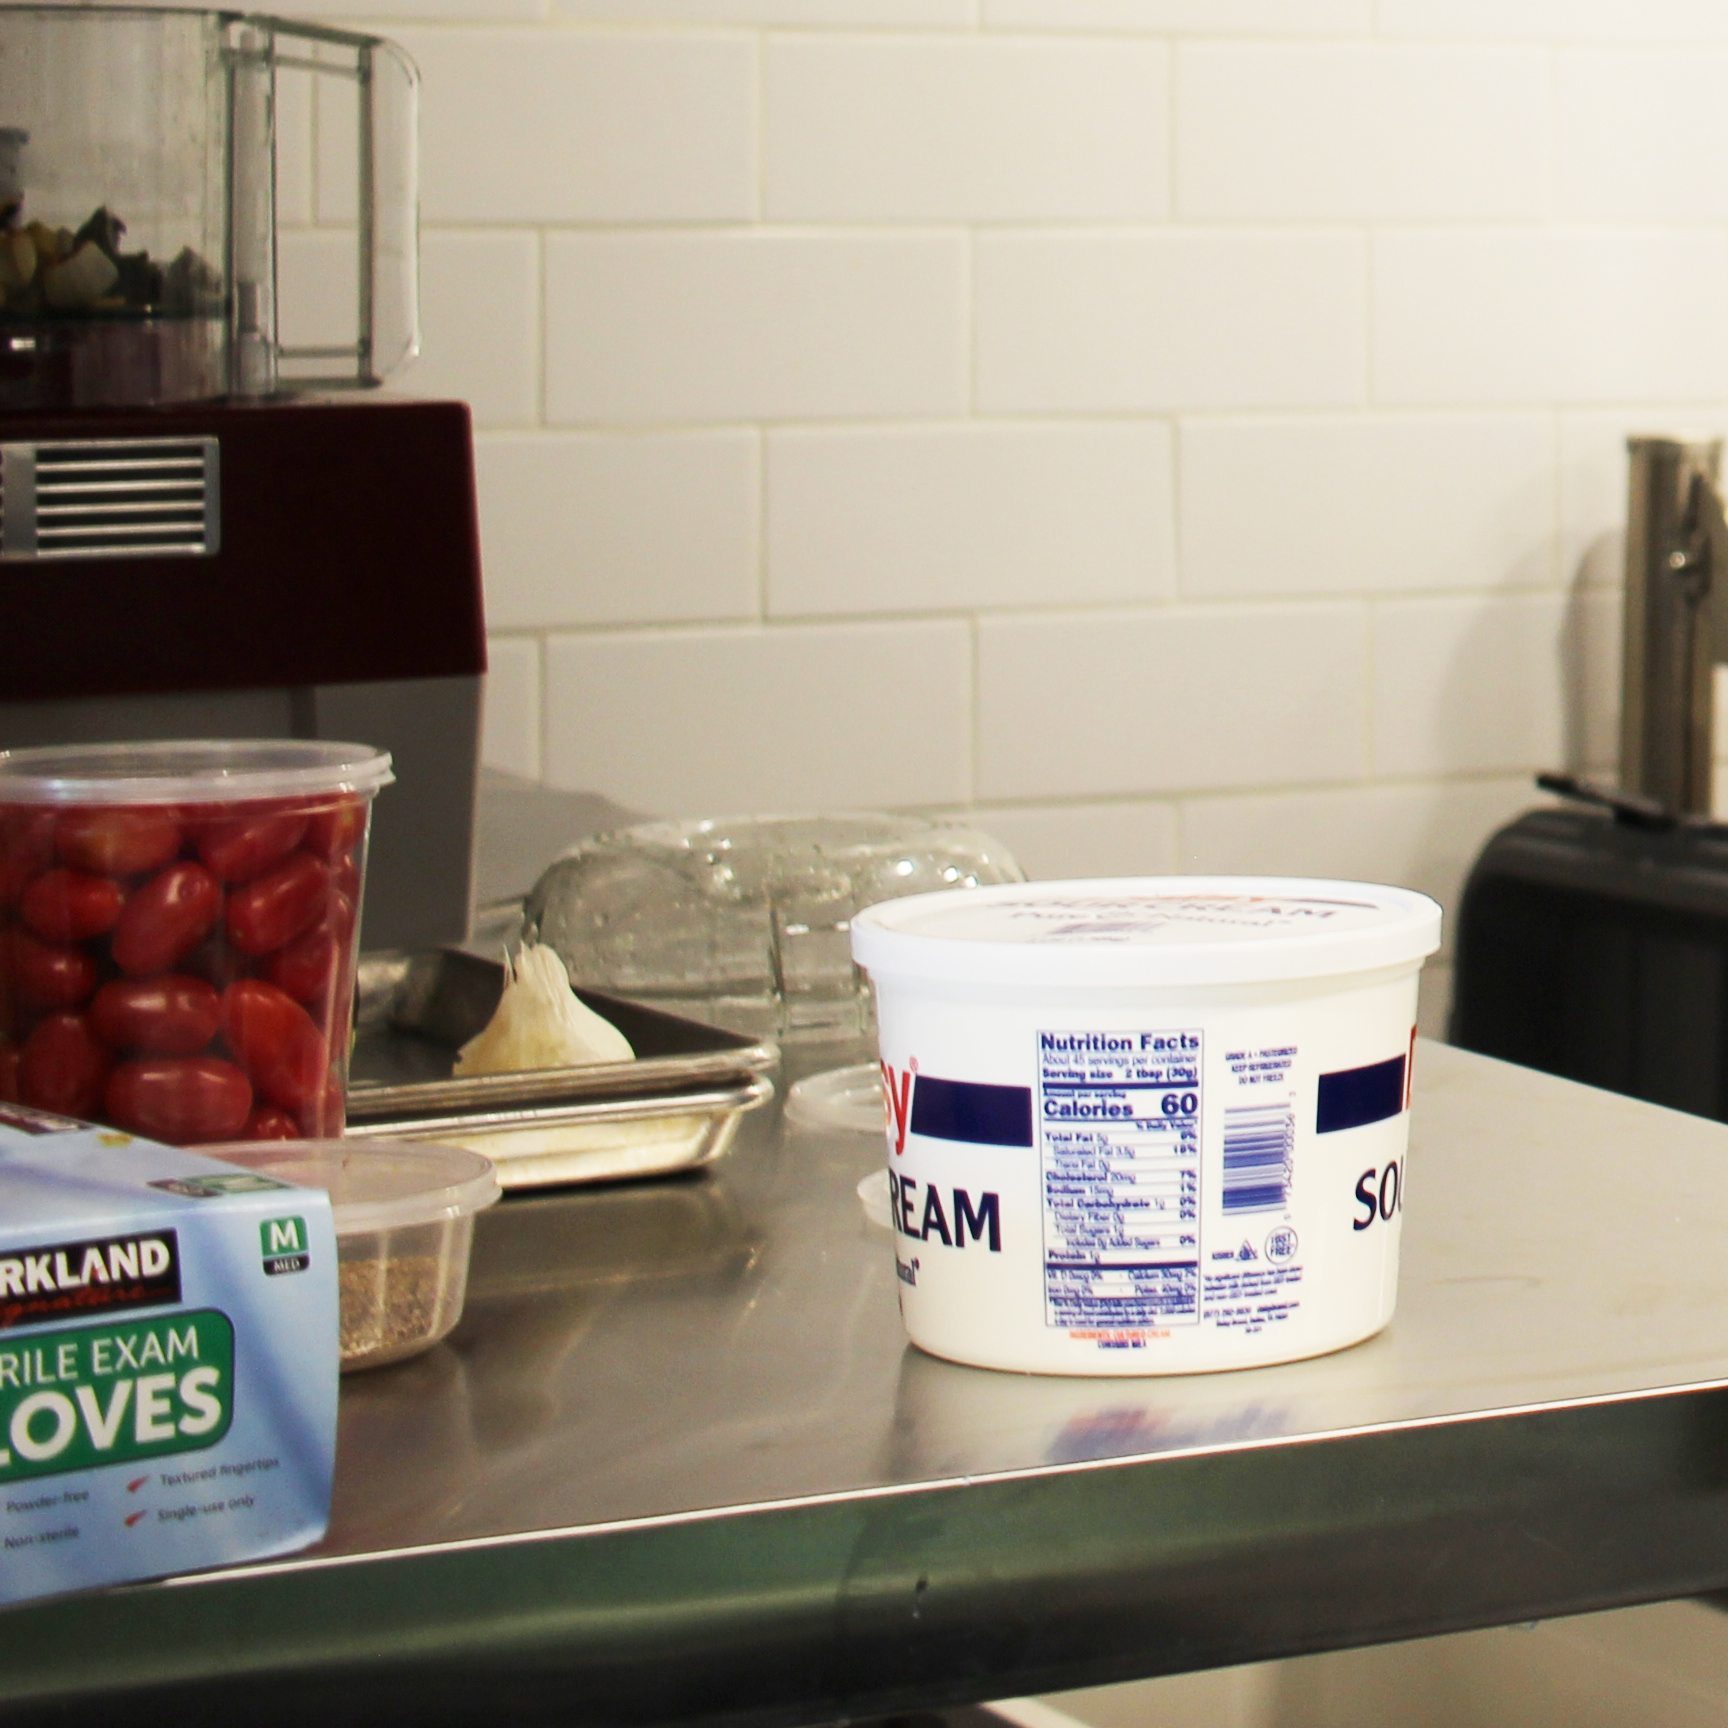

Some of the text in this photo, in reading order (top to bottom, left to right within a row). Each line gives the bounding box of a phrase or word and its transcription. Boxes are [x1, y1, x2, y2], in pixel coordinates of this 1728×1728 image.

[1041, 1032, 1199, 1050] Nutrition Facts
[1088, 1055, 1129, 1068] servings
[1132, 1055, 1147, 1067] per
[1043, 1068, 1086, 1083] Serving
[1090, 1068, 1113, 1079] size
[1125, 1069, 1132, 1079] 2
[1044, 1092, 1198, 1117] Calories 60
[1353, 1155, 1404, 1231] SO
[269, 1219, 299, 1253] M
[0, 1239, 171, 1298] RKLAND
[273, 1258, 301, 1274] MED
[0, 1325, 199, 1390] RILE EXAM
[0, 1366, 223, 1466] OVES
[227, 1493, 257, 1511] only
